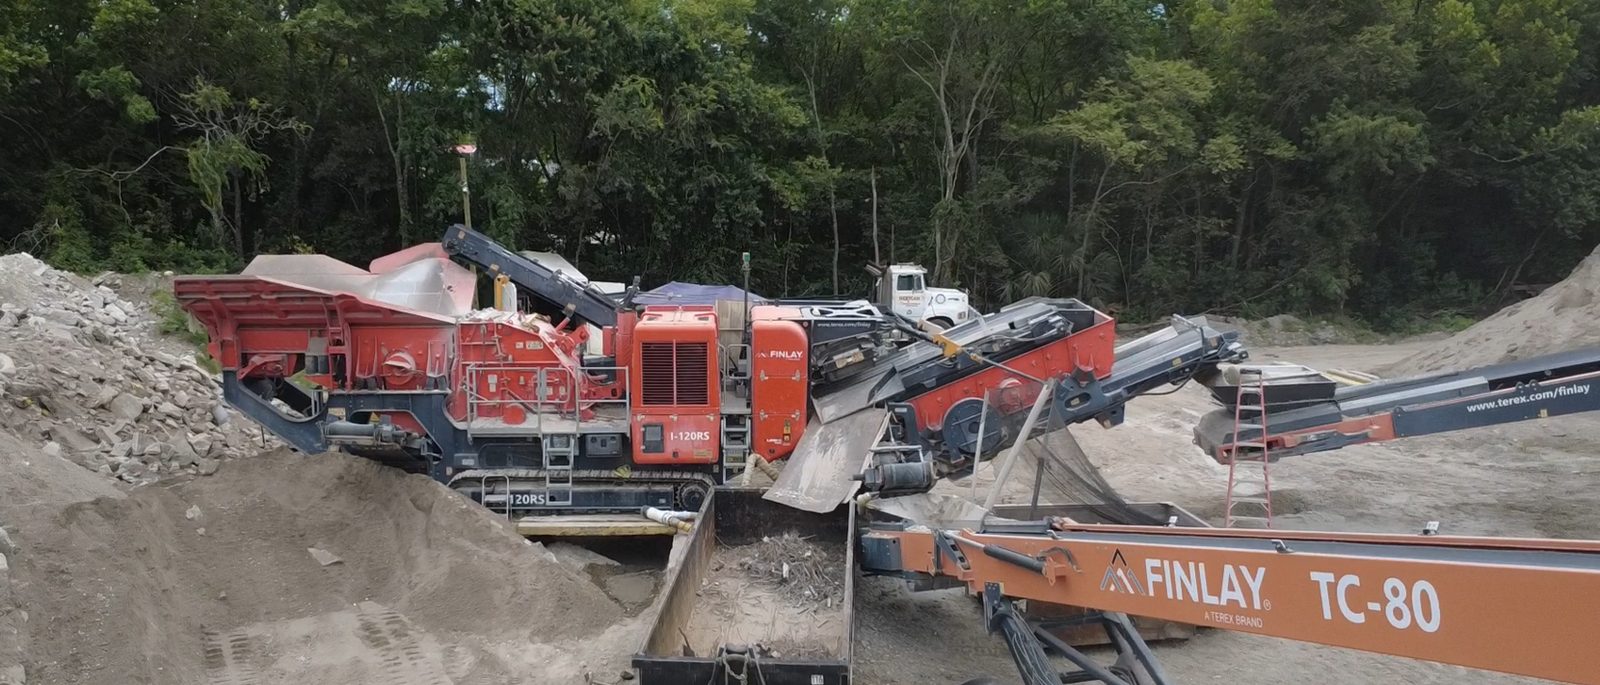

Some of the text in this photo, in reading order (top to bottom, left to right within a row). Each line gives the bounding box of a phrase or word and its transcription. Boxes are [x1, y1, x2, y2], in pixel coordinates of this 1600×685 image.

[770, 350, 803, 358] FINLAY
[1466, 384, 1590, 412] www.terex.com/finlay
[670, 431, 710, 441] I-120RS
[1309, 571, 1441, 633] TC-80
[1204, 611, 1263, 628] A TEREX BRAND
